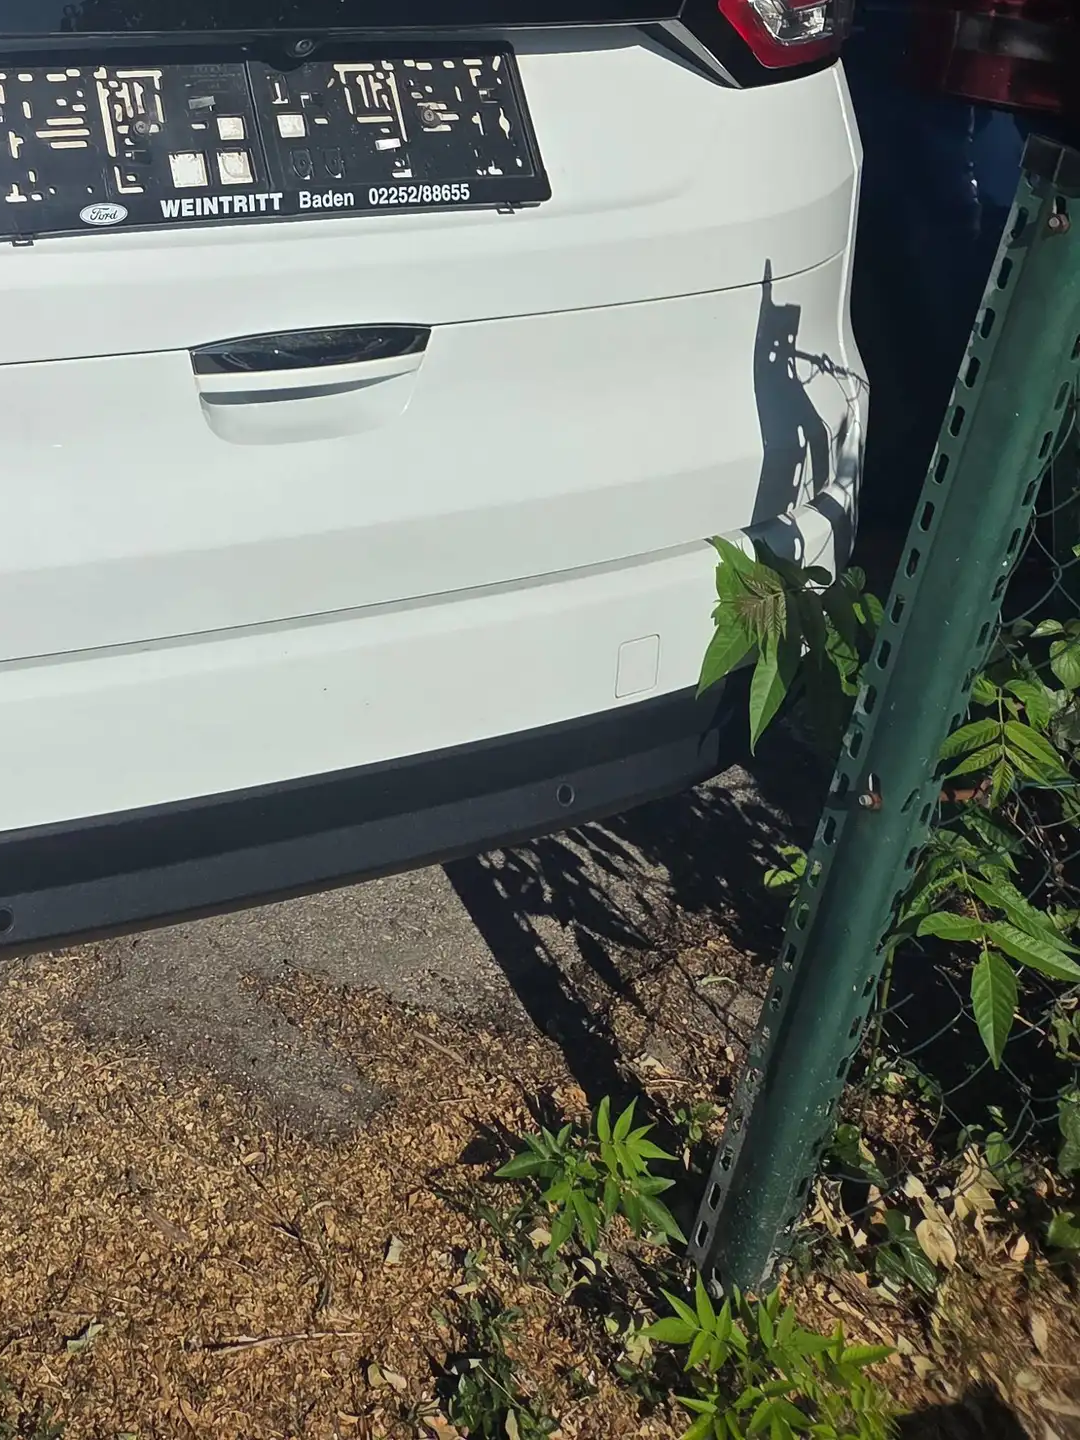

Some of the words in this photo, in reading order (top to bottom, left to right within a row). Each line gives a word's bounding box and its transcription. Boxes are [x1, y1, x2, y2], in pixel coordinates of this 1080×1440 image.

[159, 192, 284, 219] WEINTRITT
[298, 189, 355, 209] Baden
[368, 183, 470, 206] 02252/88655
